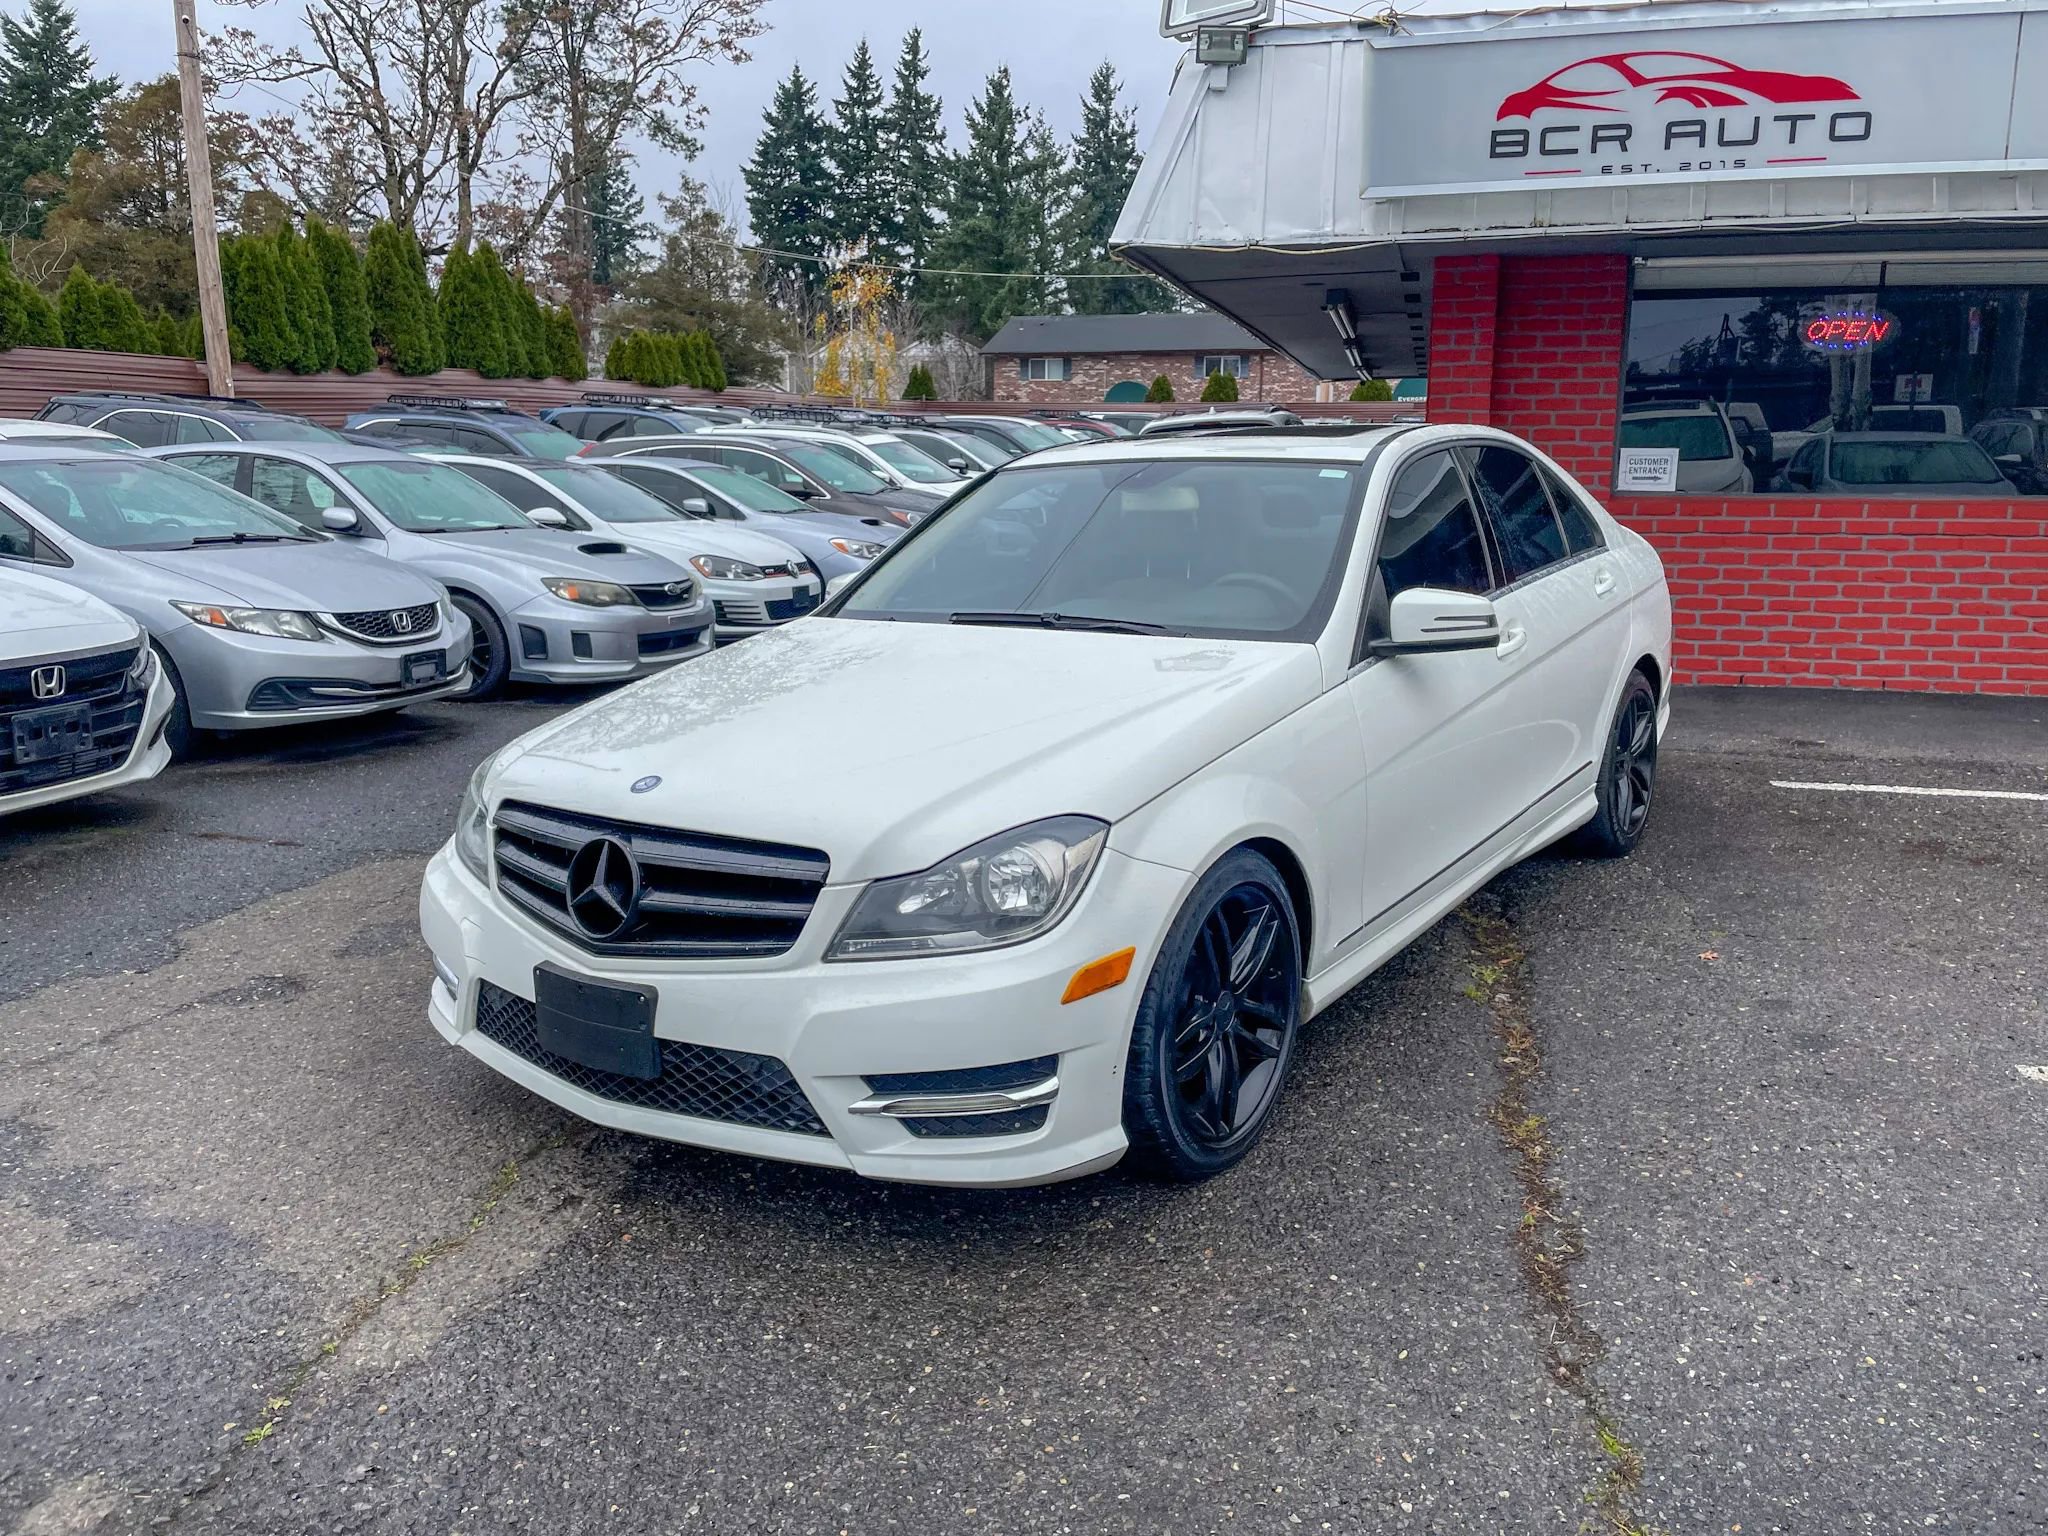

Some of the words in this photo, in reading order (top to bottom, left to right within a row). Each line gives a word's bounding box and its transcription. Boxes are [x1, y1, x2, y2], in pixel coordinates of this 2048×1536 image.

[1489, 123, 1633, 159] BCR
[1664, 111, 1873, 151] AUTO
[1601, 163, 1661, 175] EST.
[1678, 159, 1747, 172] 2015
[1807, 320, 1890, 341] OPEN
[1629, 458, 1669, 466] CUSTOMER
[1628, 467, 1668, 475] ENTRANCE
